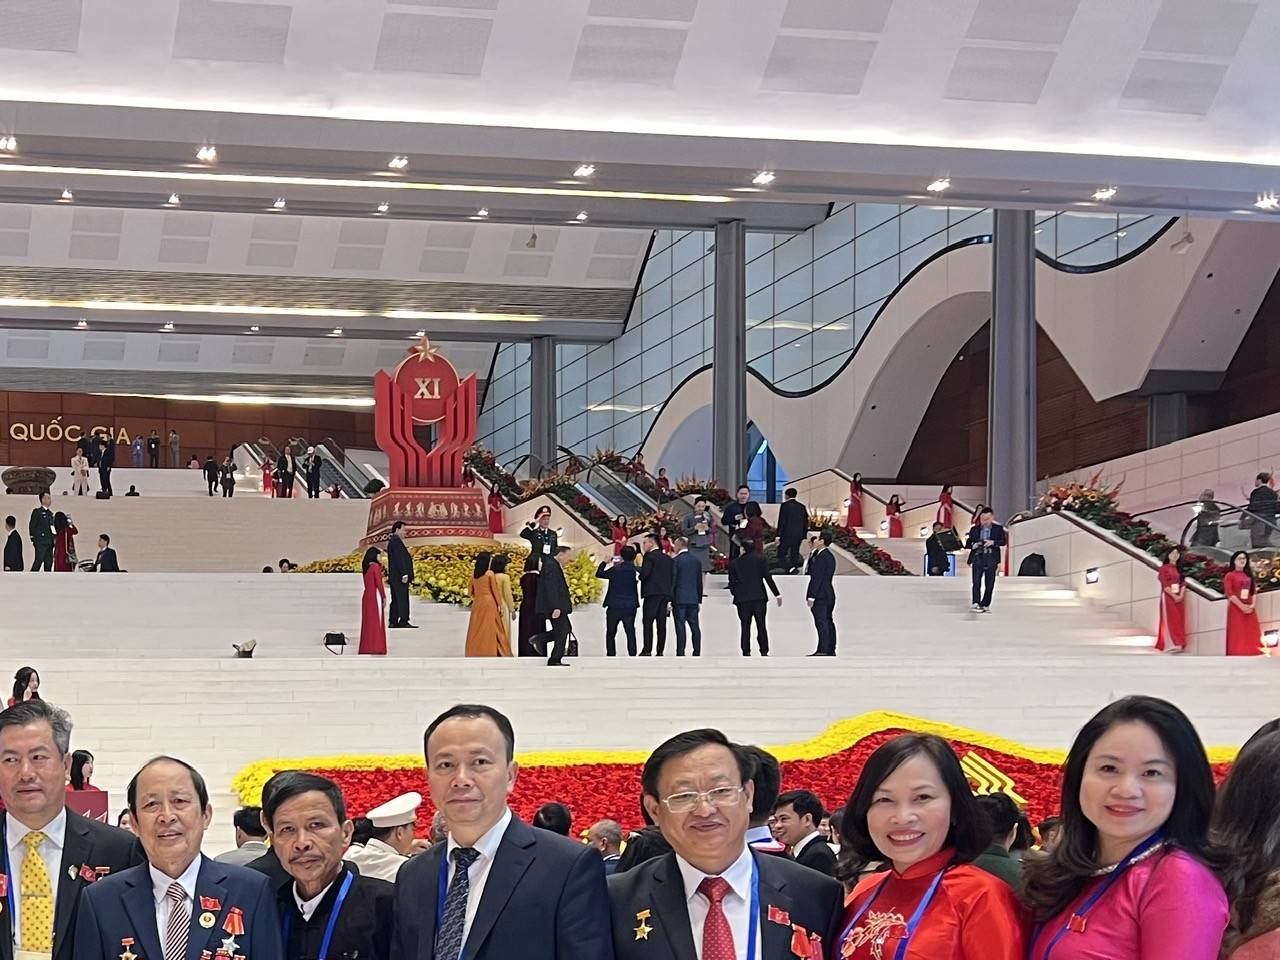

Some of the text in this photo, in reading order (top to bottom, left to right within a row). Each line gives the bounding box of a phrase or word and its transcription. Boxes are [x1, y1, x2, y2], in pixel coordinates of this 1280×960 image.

[413, 377, 441, 400] XI
[9, 415, 82, 443] QUỐC
[90, 425, 132, 446] GIA
